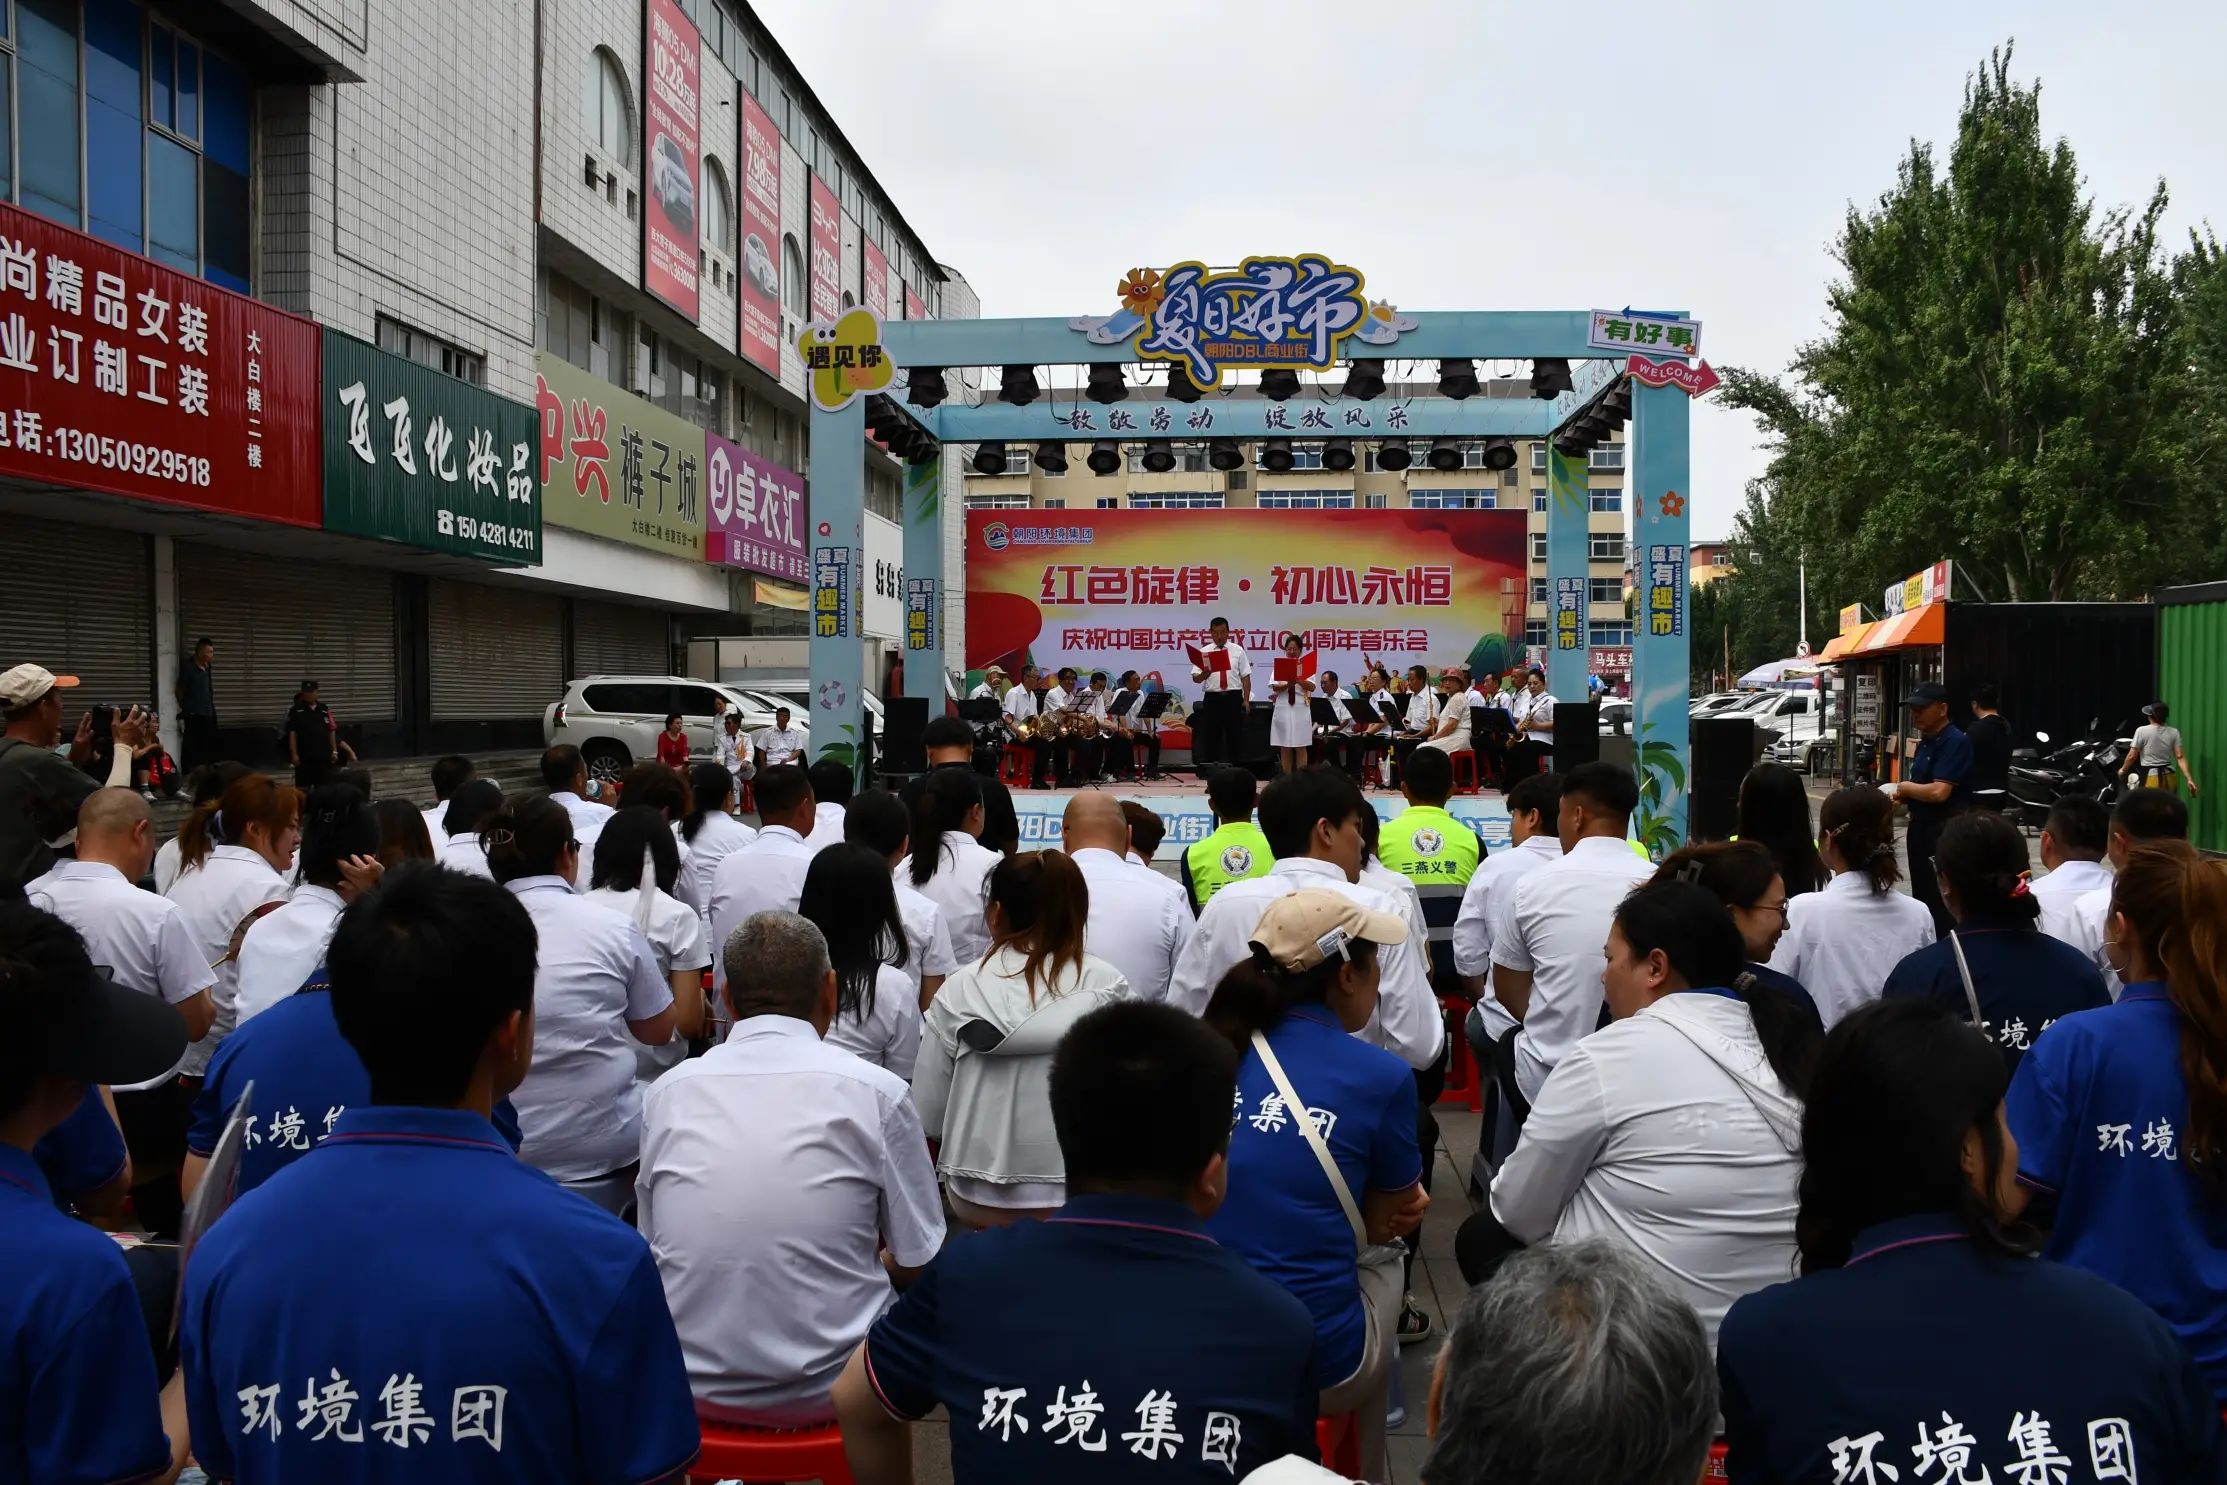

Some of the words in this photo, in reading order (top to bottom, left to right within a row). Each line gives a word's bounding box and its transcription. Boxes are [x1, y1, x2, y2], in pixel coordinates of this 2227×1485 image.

[813, 237, 838, 292] 比亚迪
[0, 235, 208, 357] 尚精品女装
[1146, 262, 1358, 382] 夏日好市
[807, 345, 882, 369] 遇见你
[1204, 343, 1308, 359] 朝阳DBL商业街
[1604, 319, 1693, 348] 有好事
[0, 312, 209, 417] 业订制工装
[1639, 363, 1703, 389] WELCOME
[247, 330, 262, 469] 大白楼二楼
[1069, 406, 1214, 432] 致敬劳动
[1265, 404, 1409, 430] 绽放风采
[339, 381, 532, 505] 飞飞化妆品
[620, 424, 698, 527] 裤子城
[736, 460, 802, 549] 卓衣汇
[457, 515, 477, 540] 150
[479, 522, 507, 546] 4281
[508, 529, 533, 550] 4211
[733, 539, 784, 573] 服装批发超市
[816, 548, 848, 564] 盛夏
[1013, 528, 1093, 539] 朝阳环境集团
[1651, 546, 1683, 562] 盛夏
[816, 565, 838, 636] 有趣市
[1652, 563, 1673, 635] 有趣市
[1858, 677, 1876, 687] 复印
[1401, 861, 1457, 874] 三燕义警
[237, 1367, 508, 1452] 环境集团
[978, 1379, 1241, 1475] 环境集团
[1827, 1410, 2138, 1485] 环境集团
